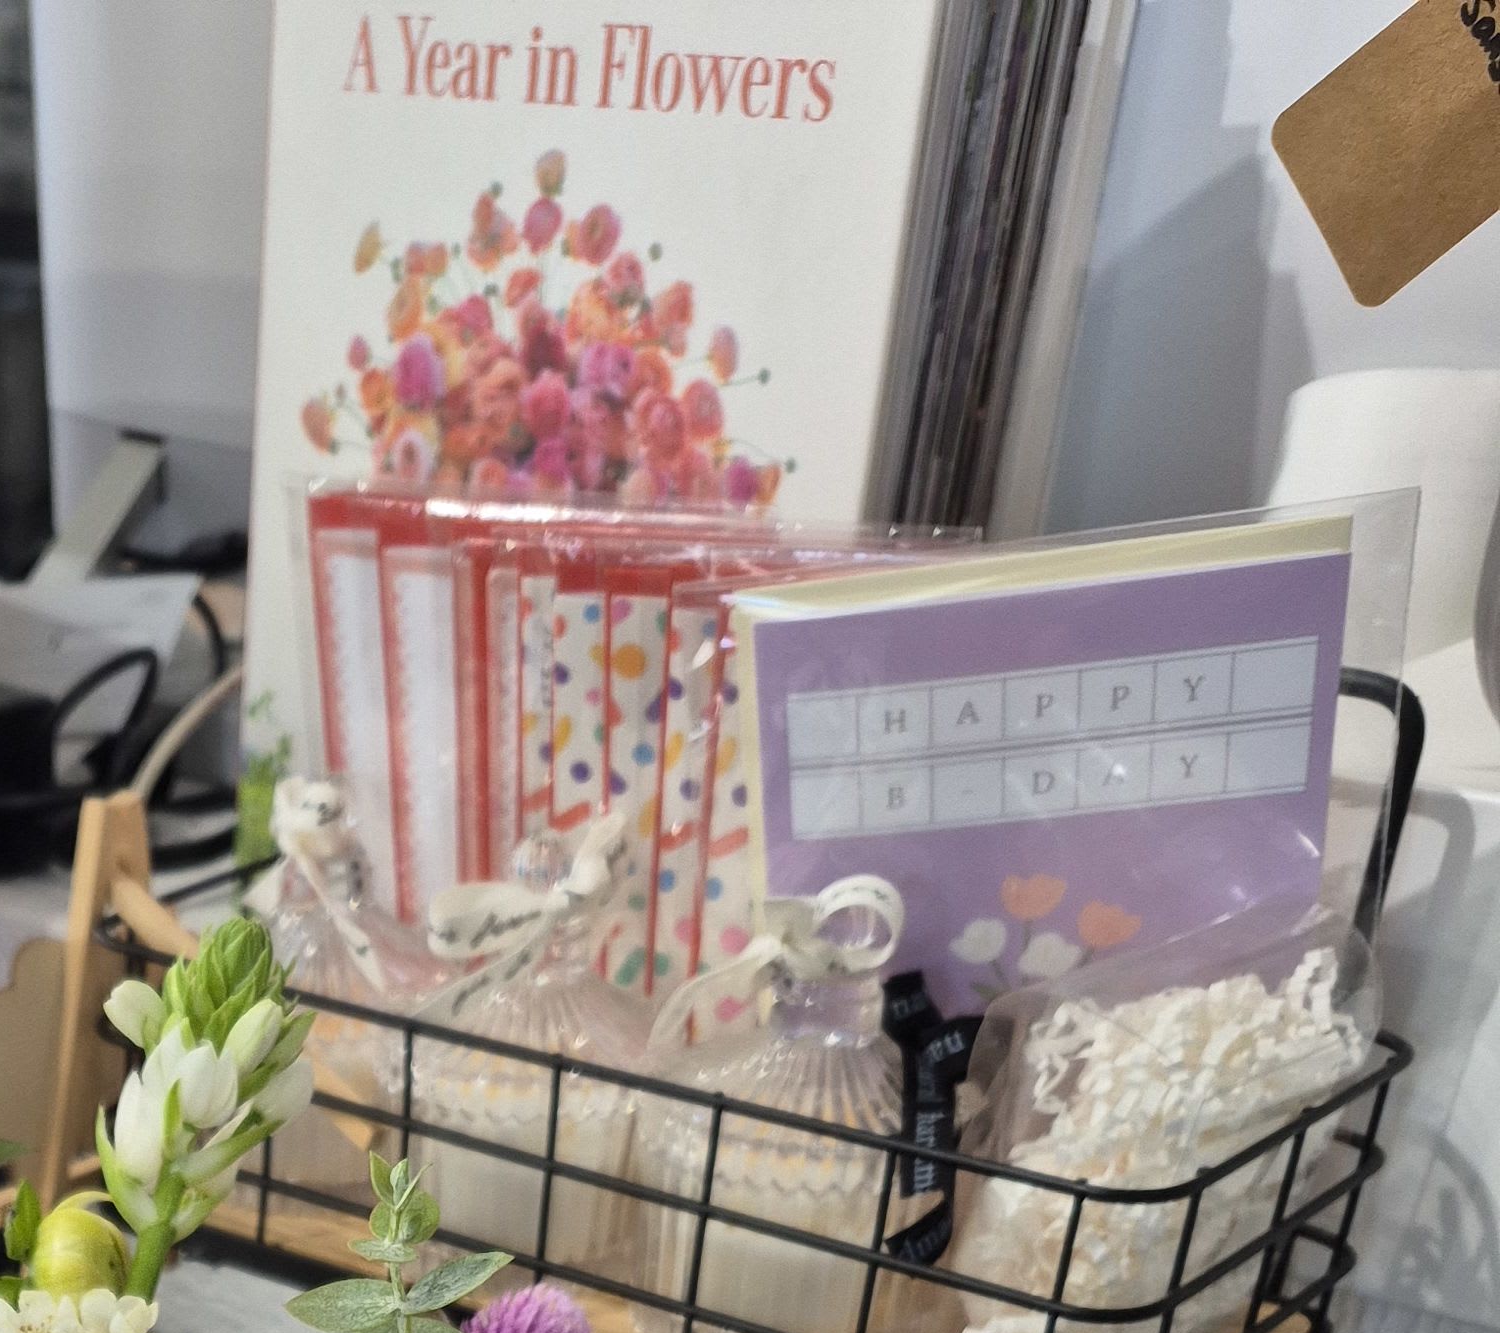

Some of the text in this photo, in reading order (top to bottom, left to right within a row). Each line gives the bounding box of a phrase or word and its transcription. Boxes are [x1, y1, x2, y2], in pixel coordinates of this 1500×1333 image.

[343, 15, 836, 123] A Year in Flowers
[883, 674, 1204, 734] HAPPY
